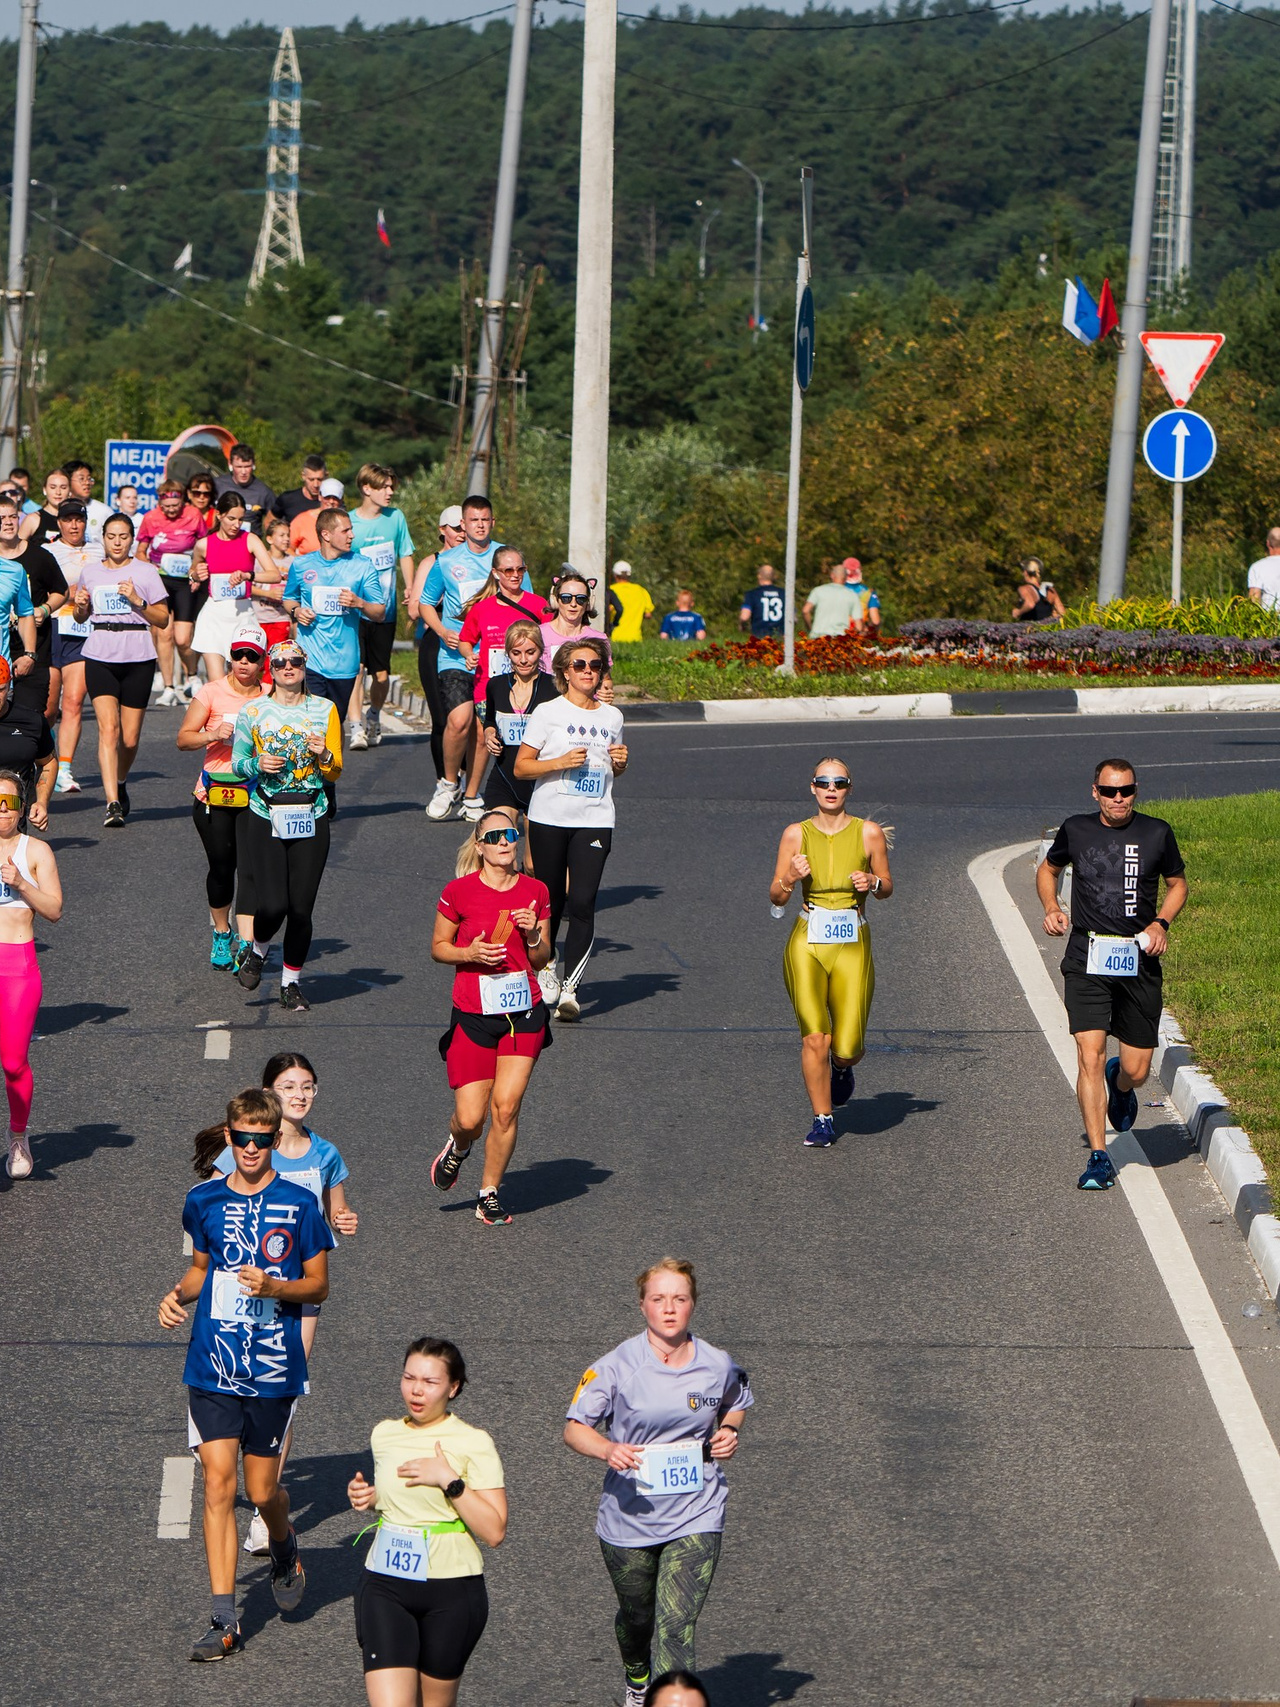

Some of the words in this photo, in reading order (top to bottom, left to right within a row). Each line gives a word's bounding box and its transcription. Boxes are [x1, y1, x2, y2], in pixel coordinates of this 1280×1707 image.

[374, 555, 394, 567] 4735
[220, 586, 243, 597] 3561
[105, 599, 128, 611] 1362
[760, 597, 784, 622] 13
[71, 622, 93, 633] 4051
[508, 728, 526, 742] 31
[575, 779, 601, 793] 4681
[221, 788, 236, 799] 23
[284, 812, 312, 820] ЕЛИЗАВЕТА
[286, 819, 313, 835] 1766
[1124, 844, 1139, 918] RUSSIA
[824, 923, 854, 939] 3469
[1111, 946, 1130, 955] СЕРГЕЙ
[1104, 955, 1135, 971] 4049
[505, 981, 523, 991] ОЛЕСЯ
[499, 989, 529, 1008] 3277
[235, 1297, 265, 1317] 220
[667, 1455, 689, 1465] АЛЕНА
[661, 1465, 699, 1488] 1534
[391, 1537, 413, 1549] ЕЛЕНА
[384, 1548, 422, 1574] 1437
